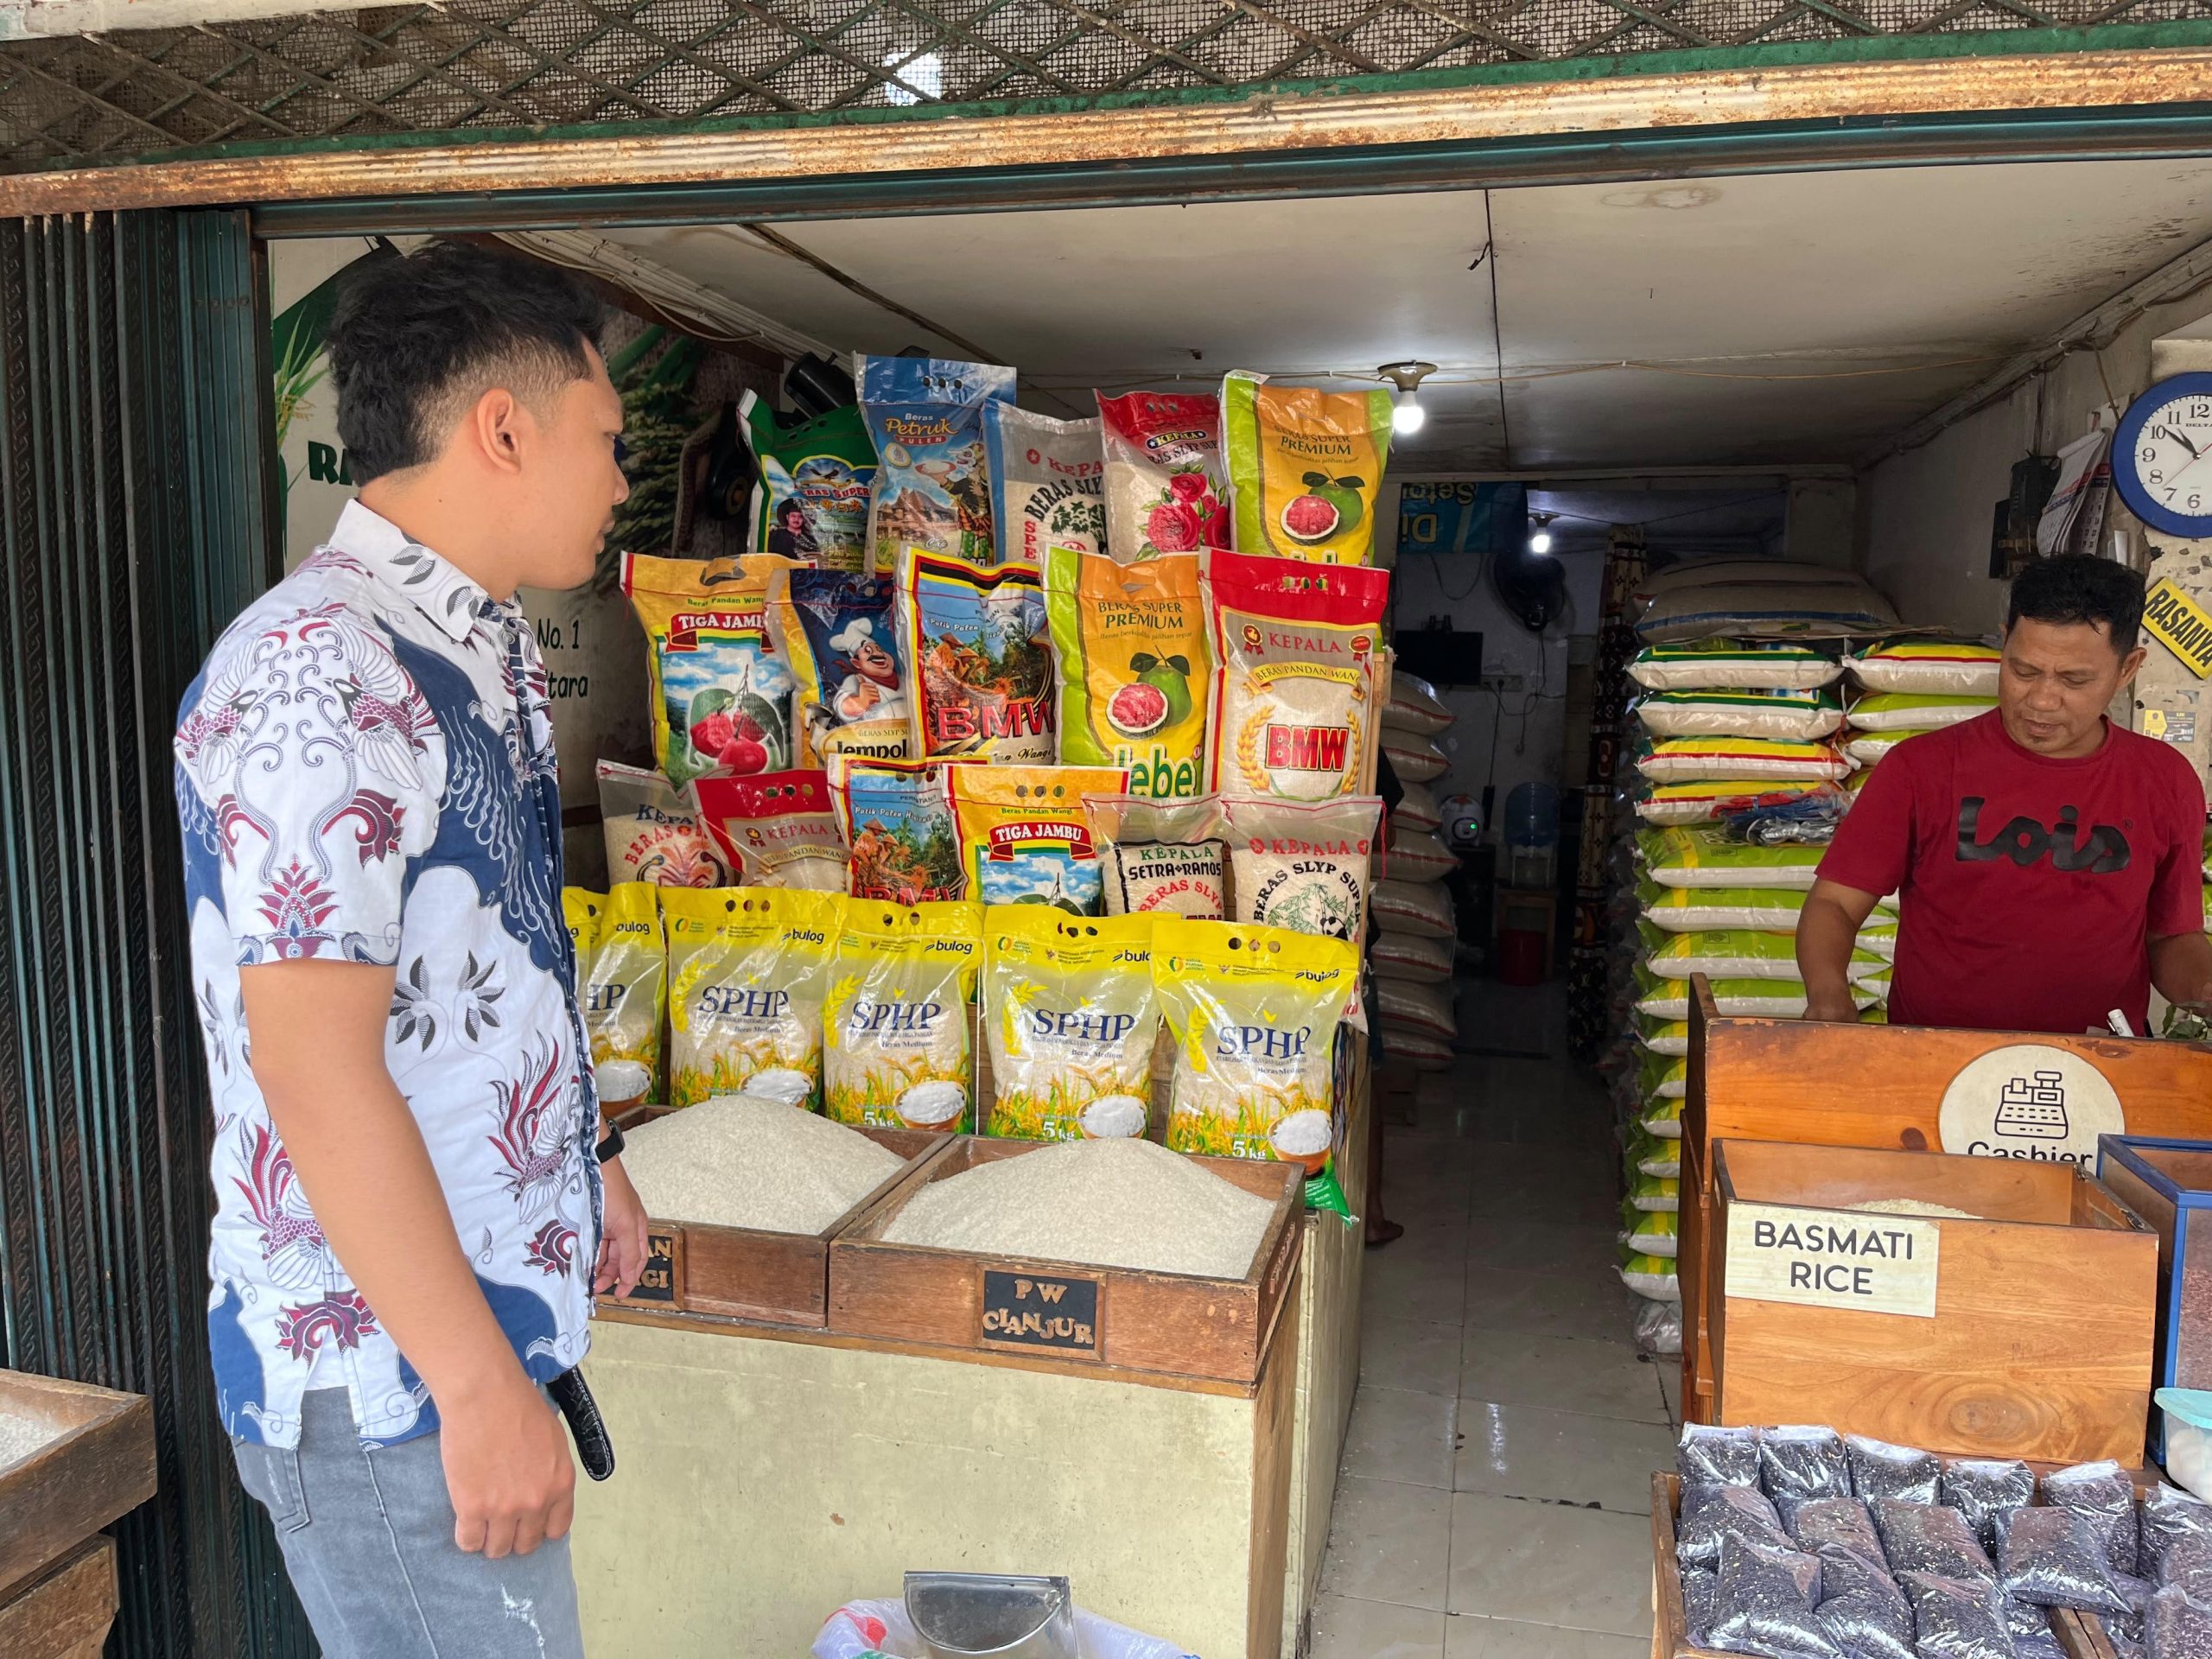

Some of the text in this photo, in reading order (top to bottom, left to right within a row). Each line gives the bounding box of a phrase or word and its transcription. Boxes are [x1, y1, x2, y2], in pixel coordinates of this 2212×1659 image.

[905, 413, 933, 422] Beras
[2166, 410, 2181, 424] 11
[2189, 404, 2209, 419] 12
[885, 417, 958, 435] Petruk
[1274, 425, 1351, 442] BERAS SUPER
[2150, 424, 2166, 440] 10
[899, 435, 943, 445] PULEN
[1156, 431, 1198, 446] KEPALA
[1281, 435, 1351, 455] PREMIUM
[1173, 442, 1200, 458] SLYP
[2143, 448, 2156, 462] 9
[1047, 457, 1103, 477] KEPA
[2149, 469, 2163, 484] 8
[832, 486, 872, 499] SUPER
[1024, 479, 1073, 522] BERAS
[2164, 487, 2177, 501] 7
[2187, 493, 2201, 509] 6
[1098, 602, 1183, 613] BERAS SUPER
[678, 614, 719, 630] TIGA
[1106, 613, 1184, 629] PREMIUM
[2145, 588, 2212, 668] RASANYA
[537, 618, 580, 650] No. 1
[1268, 632, 1343, 653] KEPALA
[1255, 666, 1283, 681] BERAS
[1284, 665, 1327, 677] PANDAN
[546, 671, 588, 699] tara
[938, 701, 1053, 740] BMW
[859, 728, 881, 737] BERAS
[1018, 747, 1052, 760] Wangi
[1265, 724, 1350, 772] BMW
[637, 804, 694, 825] KEPA
[766, 823, 829, 840] KEPALA
[995, 823, 1083, 842] TIGA JAMBU
[625, 824, 674, 865] BERAS
[1270, 838, 1351, 855] KEPALA
[785, 848, 821, 860] PANDAN
[1140, 846, 1214, 861] KEPALA
[1129, 861, 1222, 880] SETRA RAMOS
[1138, 880, 1189, 912] BERAS
[1254, 869, 1288, 923] BERAS
[1293, 861, 1337, 874] SLYP
[792, 928, 824, 944] bulog
[936, 940, 973, 955] bulog
[699, 986, 790, 1017] SPHP
[850, 1002, 941, 1031] SPHP
[1033, 1008, 1135, 1041] SPHP
[1217, 1026, 1312, 1059] SPHP
[1043, 1121, 1055, 1138] 5
[1232, 1140, 1246, 1158] 5
[648, 1239, 672, 1258] N
[1754, 1220, 1913, 1260] BASMATI
[1790, 1261, 1873, 1294] RICE
[982, 1307, 1094, 1344] CIANJUR
